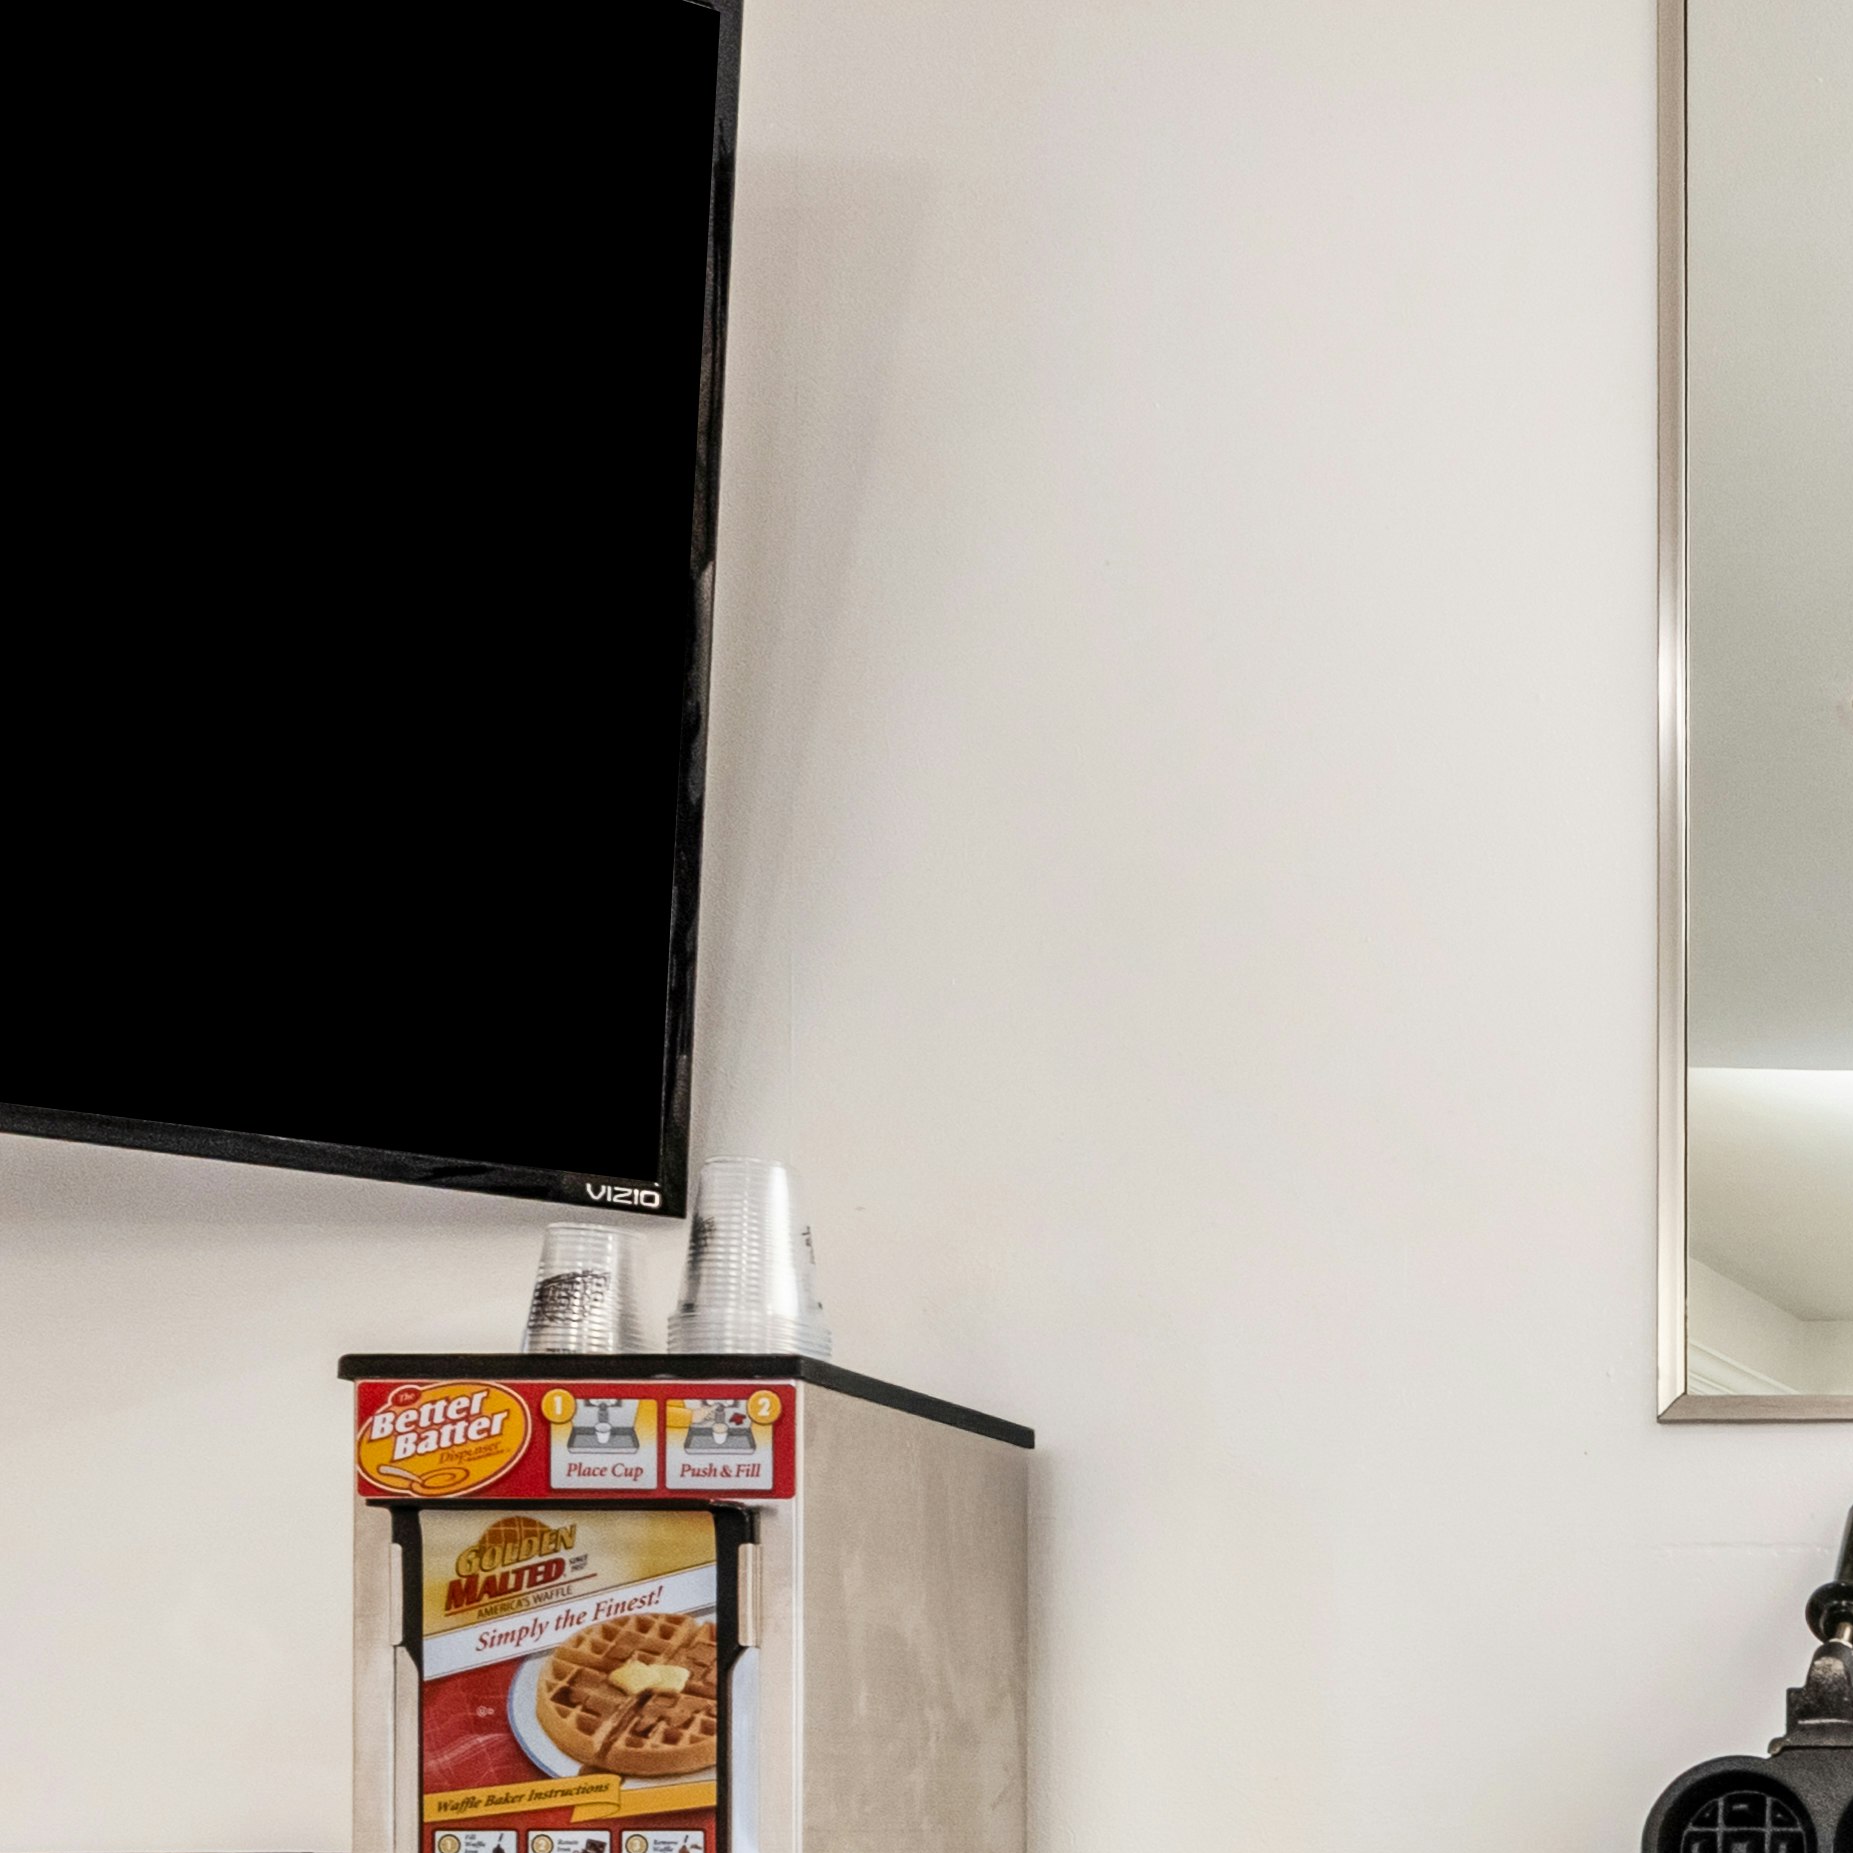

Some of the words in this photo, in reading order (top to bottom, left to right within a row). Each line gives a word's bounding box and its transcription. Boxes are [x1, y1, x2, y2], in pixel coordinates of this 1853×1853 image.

[585, 1182, 661, 1209] VIZIO
[369, 1389, 489, 1442] Better
[553, 1395, 563, 1416] 1
[757, 1397, 771, 1417] 2
[391, 1410, 509, 1462] Batter
[438, 1441, 501, 1465] Dispenser
[566, 1462, 607, 1478] Place
[611, 1462, 644, 1482] Cup
[680, 1463, 717, 1478] Push
[720, 1464, 732, 1478] &
[735, 1463, 761, 1478] Fill
[455, 1524, 577, 1578] GOLDEN
[444, 1557, 567, 1612] MALTED
[475, 1616, 550, 1652] Simply
[554, 1608, 589, 1632] the
[593, 1584, 664, 1620] Finest!
[477, 1593, 531, 1620] AMERICA'S
[532, 1584, 574, 1606] WAFFLE
[437, 1796, 482, 1814] Waffle
[484, 1791, 525, 1807] Baker
[527, 1781, 610, 1803] Instructions
